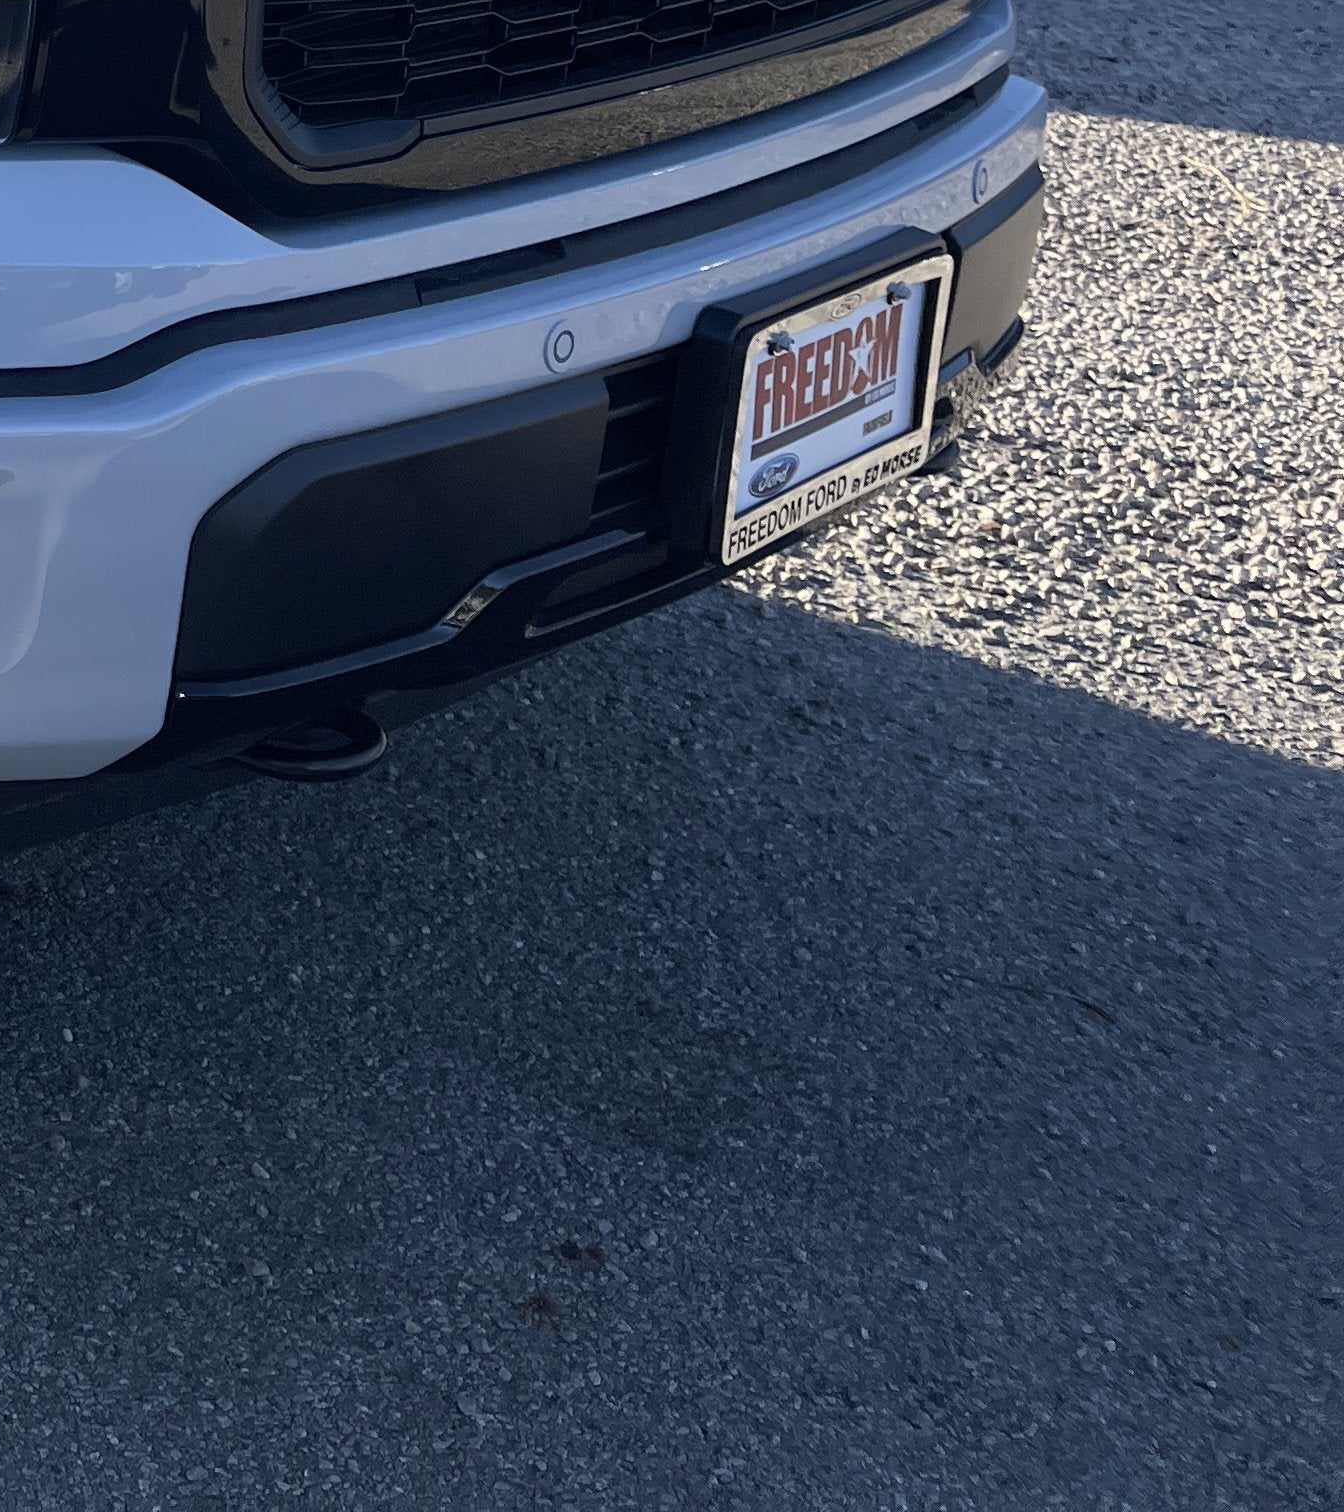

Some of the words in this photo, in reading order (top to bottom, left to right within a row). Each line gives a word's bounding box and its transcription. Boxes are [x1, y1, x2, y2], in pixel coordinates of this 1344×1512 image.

[752, 302, 904, 442] FREEDOM
[728, 496, 803, 559] FREEDOM
[805, 475, 848, 517] FORD
[863, 462, 880, 488] ED
[880, 445, 923, 480] MORSE
[757, 462, 792, 492] Ford
